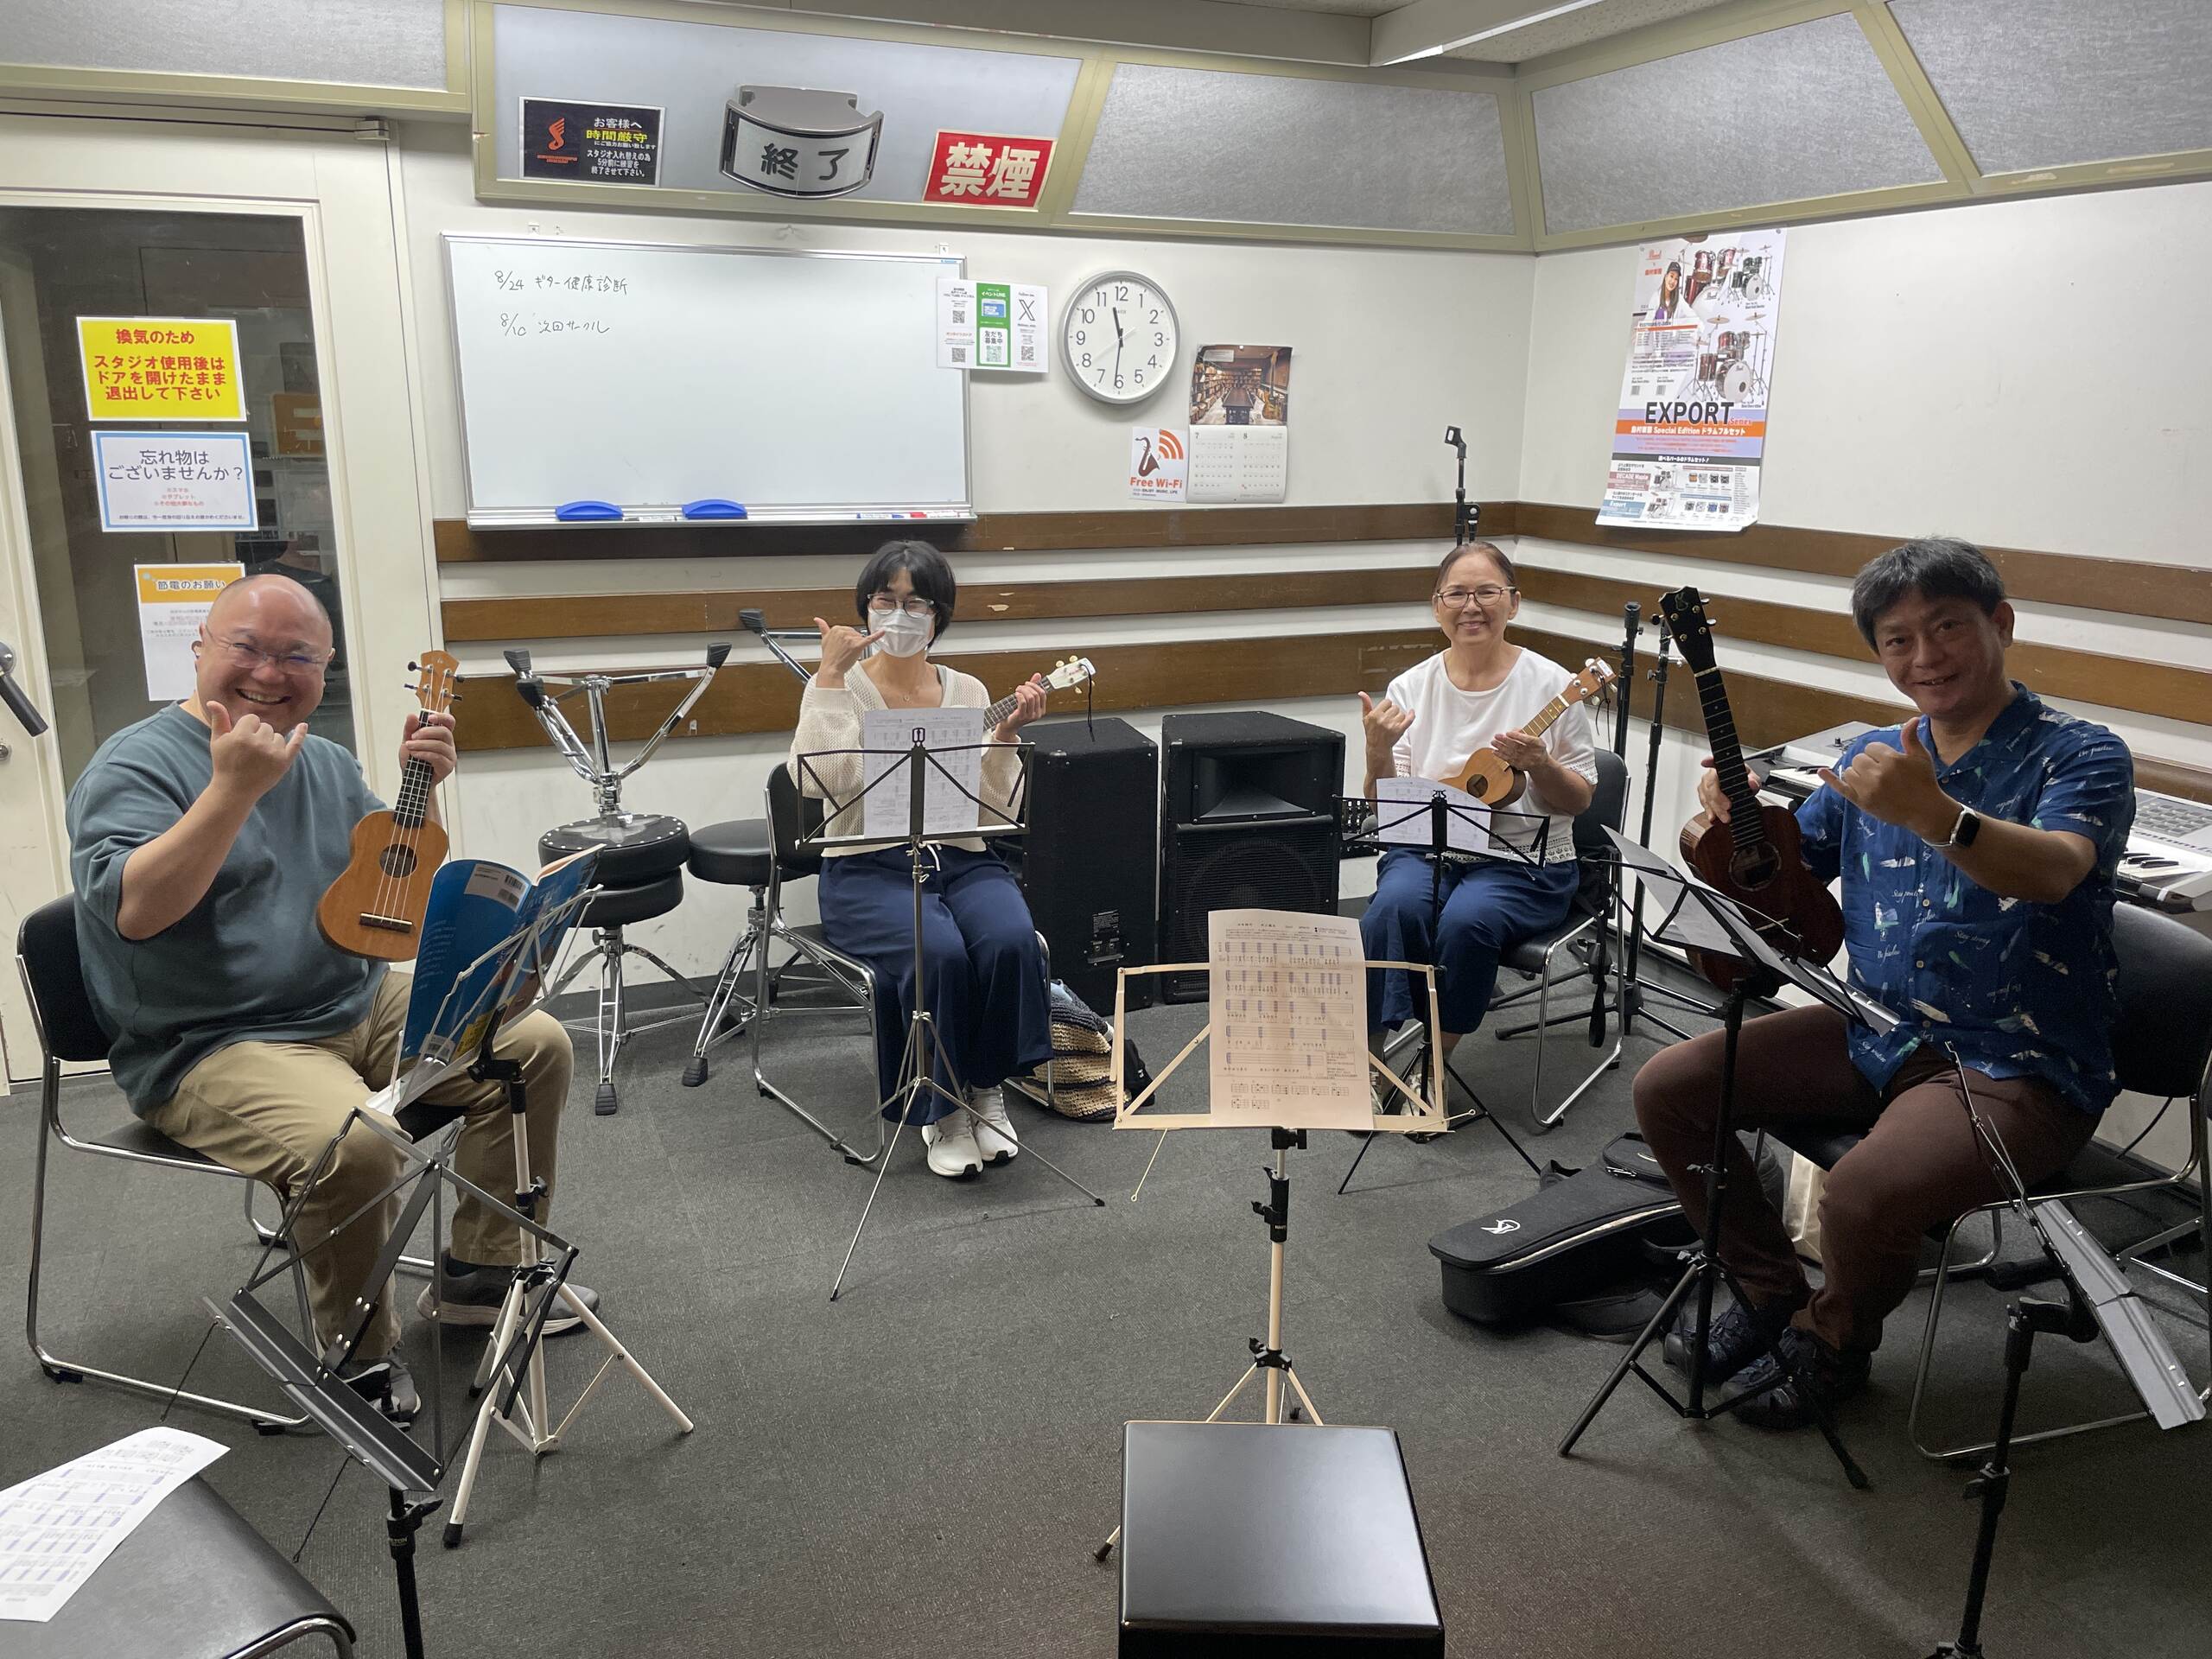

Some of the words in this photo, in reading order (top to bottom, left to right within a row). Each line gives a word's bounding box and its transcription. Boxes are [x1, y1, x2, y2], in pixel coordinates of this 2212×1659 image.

[594, 117, 643, 129] お客様へ
[586, 130, 648, 143] 時間厳守
[587, 149, 652, 162] スタジオ入れ替えの為
[761, 143, 850, 181] 終了
[938, 142, 1040, 200] 禁煙
[494, 270, 524, 291] 8/24
[1096, 291, 1107, 307] 11
[1115, 286, 1128, 302] 12
[1139, 293, 1143, 308] 1
[1081, 308, 1095, 324] 10
[1149, 309, 1159, 324] 2
[500, 313, 527, 337] 8/10
[116, 328, 195, 345] 換気のため
[1076, 330, 1086, 346] 9
[1154, 332, 1164, 346] 3
[94, 355, 226, 371] スタジオ使用後は
[1081, 353, 1091, 367] 8
[1147, 354, 1158, 369] 4
[98, 371, 226, 385] ドアを開けたまま
[1096, 368, 1106, 384] 7
[1115, 374, 1124, 389] 6
[1135, 369, 1143, 384] 5
[105, 385, 220, 401] 退出して下さい
[1645, 402, 1734, 425] EXPORT
[1654, 427, 1676, 435] Special
[1701, 428, 1745, 436] ドラムフルセット
[139, 449, 210, 466] 忘れ物は
[109, 465, 243, 480] ございませんか？
[1130, 477, 1154, 487] Free
[1156, 478, 1183, 489] Wi-Fi
[158, 581, 226, 590] 節電のお願い
